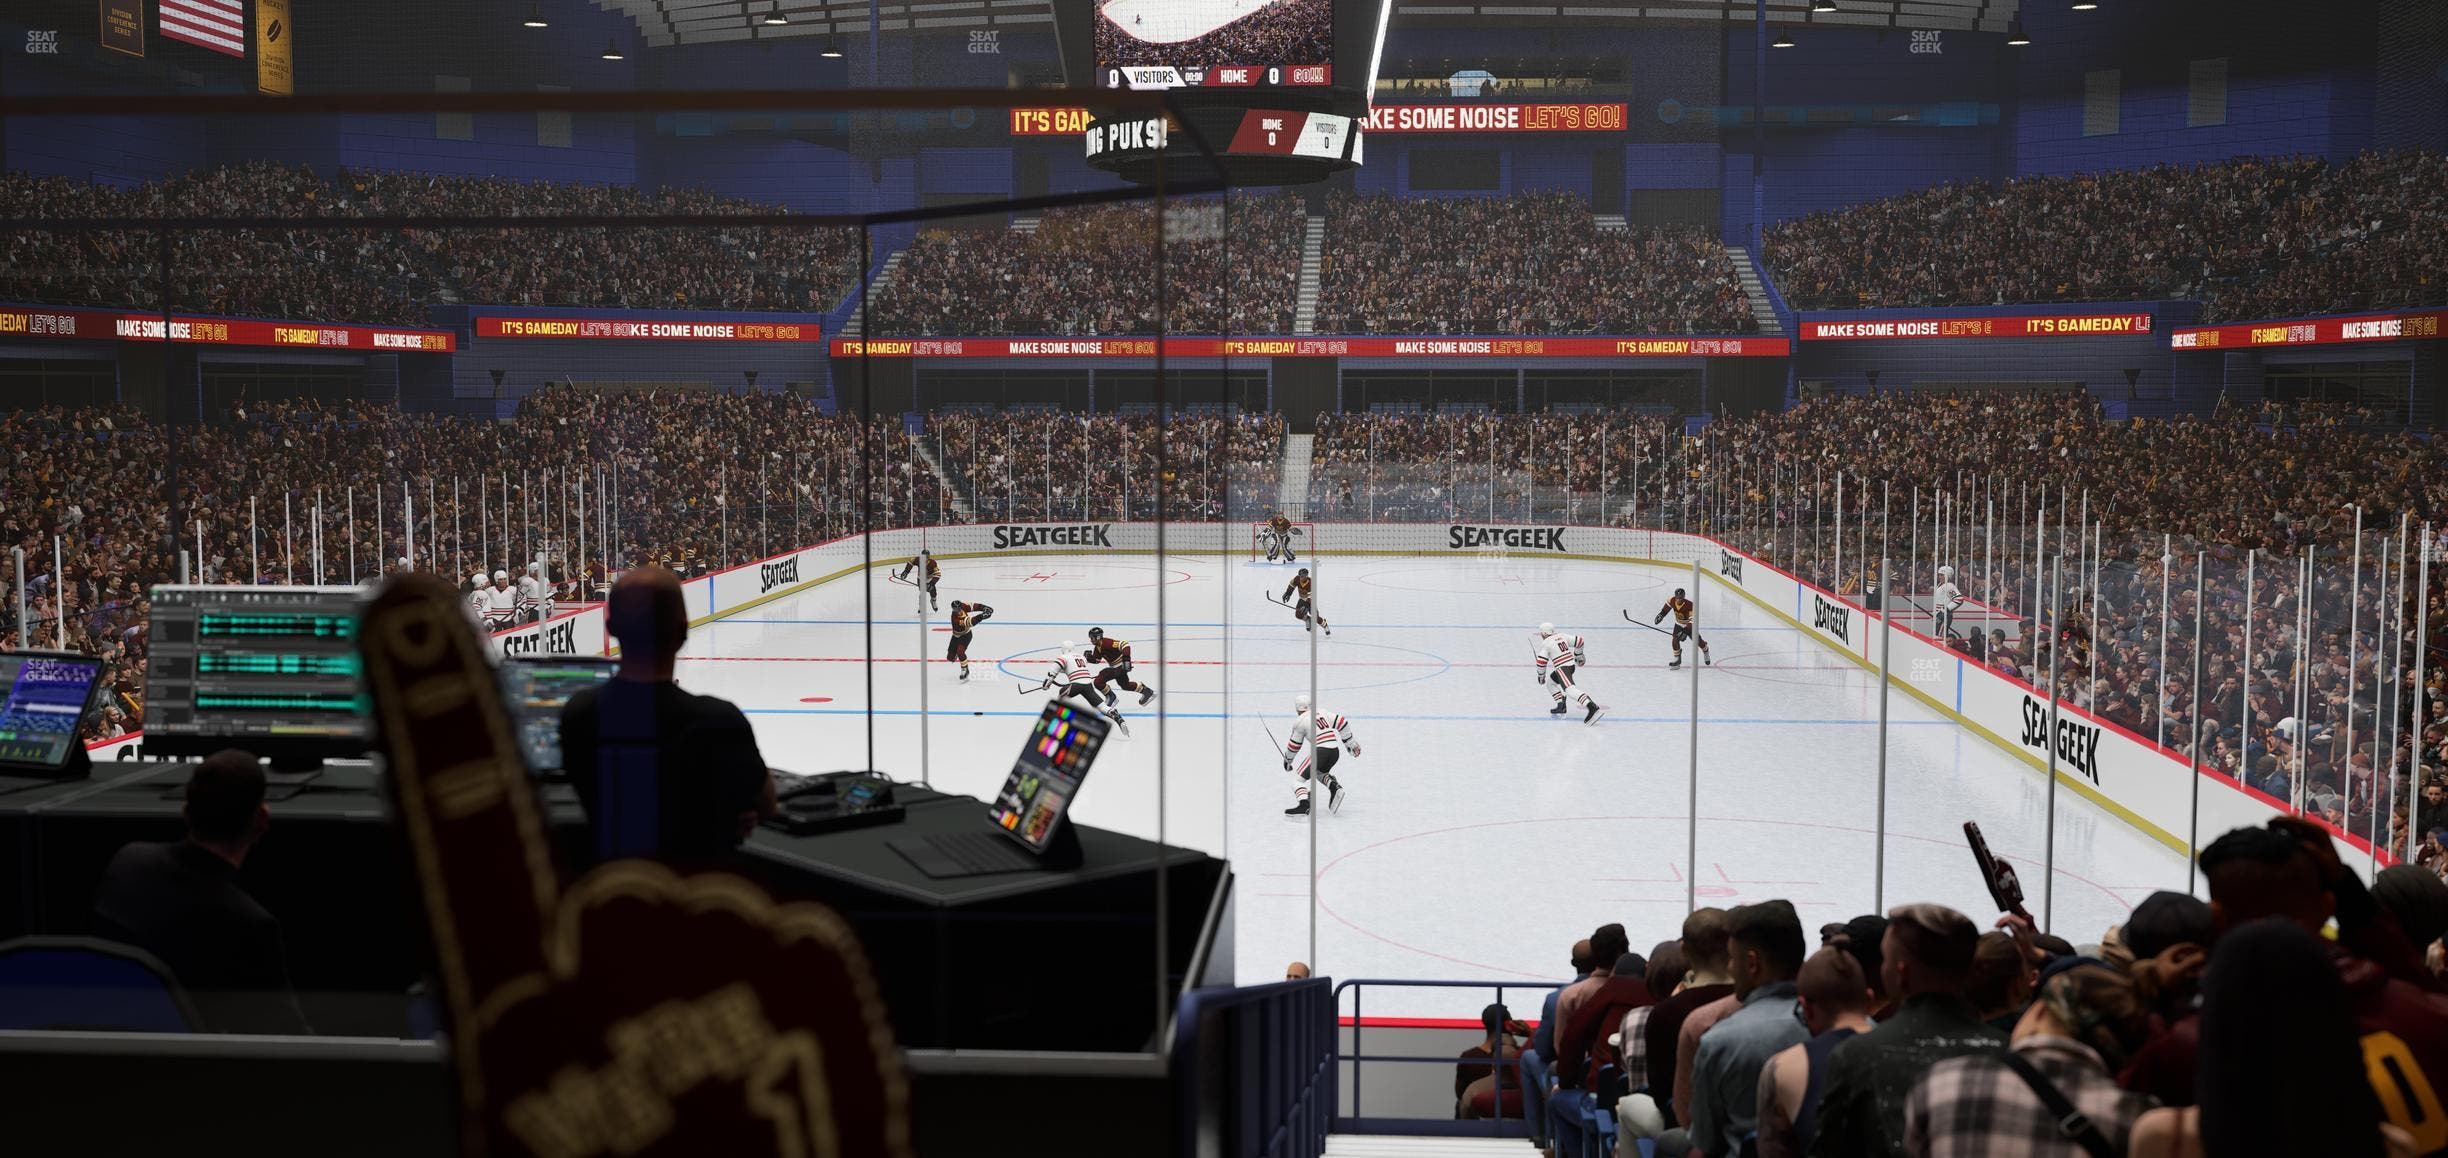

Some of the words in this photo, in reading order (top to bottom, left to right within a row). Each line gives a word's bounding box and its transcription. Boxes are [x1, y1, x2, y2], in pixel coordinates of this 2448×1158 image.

[107, 15, 137, 30] CONFERENCE
[1109, 68, 1119, 85] 0
[1133, 68, 1174, 84] VISITORS
[1220, 69, 1248, 83] HOME
[1269, 67, 1279, 84] 0
[1293, 67, 1324, 83] GO!!!
[1015, 111, 1050, 132] IT'S
[1262, 118, 1282, 130] HOME
[1399, 107, 1455, 129] SOME
[1459, 107, 1519, 129] NOISE
[1524, 106, 1580, 128] LET'S
[1584, 105, 1620, 128] GO!
[1315, 121, 1337, 134] VISITORS
[1268, 132, 1276, 146] 0
[1324, 136, 1330, 148] 0
[29, 314, 57, 333] LET'S
[58, 316, 76, 335] GO!
[116, 319, 141, 337] MAKE
[191, 322, 214, 340] LET'S
[501, 321, 524, 335] IT'S
[525, 321, 578, 336] GAMEDAY
[580, 322, 611, 336] LET'S
[651, 324, 691, 338] SOME
[693, 325, 734, 338] NOISE
[736, 325, 774, 339] LET'S
[776, 326, 800, 339] GO!
[1817, 323, 1854, 337] MAKE
[1856, 323, 1895, 337] SOME
[1897, 322, 1938, 336] NOISE
[1941, 321, 1982, 335] LET'S
[2026, 319, 2055, 333] IT'S
[2058, 317, 2132, 332] GAMEDAY
[2342, 322, 2361, 339] MAKE
[2361, 321, 2380, 338] SOME
[2381, 319, 2402, 337] NOISE
[2402, 317, 2423, 336] LET'S
[275, 327, 289, 343] IT'S
[288, 328, 318, 345] GAMEDAY
[373, 333, 391, 347] MAKE
[391, 334, 406, 348] SOME
[406, 334, 422, 348] NOISE
[2183, 333, 2197, 347] NOISE
[2251, 329, 2262, 343] IT'S
[2262, 327, 2288, 342] GAMEDAY
[2288, 326, 2304, 341] LET'S
[843, 342, 862, 354] IT'S
[913, 341, 942, 354] LET'S
[943, 341, 962, 354] GO!
[1009, 342, 1039, 354] MAKE
[1040, 342, 1070, 354] SOME
[1071, 342, 1102, 354] NOISE
[1104, 341, 1133, 354] LET'S
[1134, 341, 1154, 354] GO!
[1246, 341, 1296, 354] GAMEDAY
[1297, 341, 1327, 354] LET'S
[1328, 341, 1348, 354] GO!
[1395, 341, 1426, 354] MAKE
[1427, 341, 1457, 354] SOME
[1459, 341, 1490, 354] NOISE
[1492, 341, 1522, 354] LET'S
[1524, 341, 1543, 354] GO!
[1616, 341, 1636, 353] IT'S
[1638, 341, 1688, 353] GAMEDAY
[1690, 341, 1720, 354] LET'S
[1722, 341, 1742, 354] GO!
[993, 523, 1112, 549] SEATGEEK
[1449, 525, 1566, 552] SEATGEEK
[761, 553, 799, 594] SEATGEEK
[1721, 548, 1743, 586] SEATGEEK
[1814, 593, 1849, 646] SEATGEEK
[2022, 694, 2100, 786] SEAGEEK
